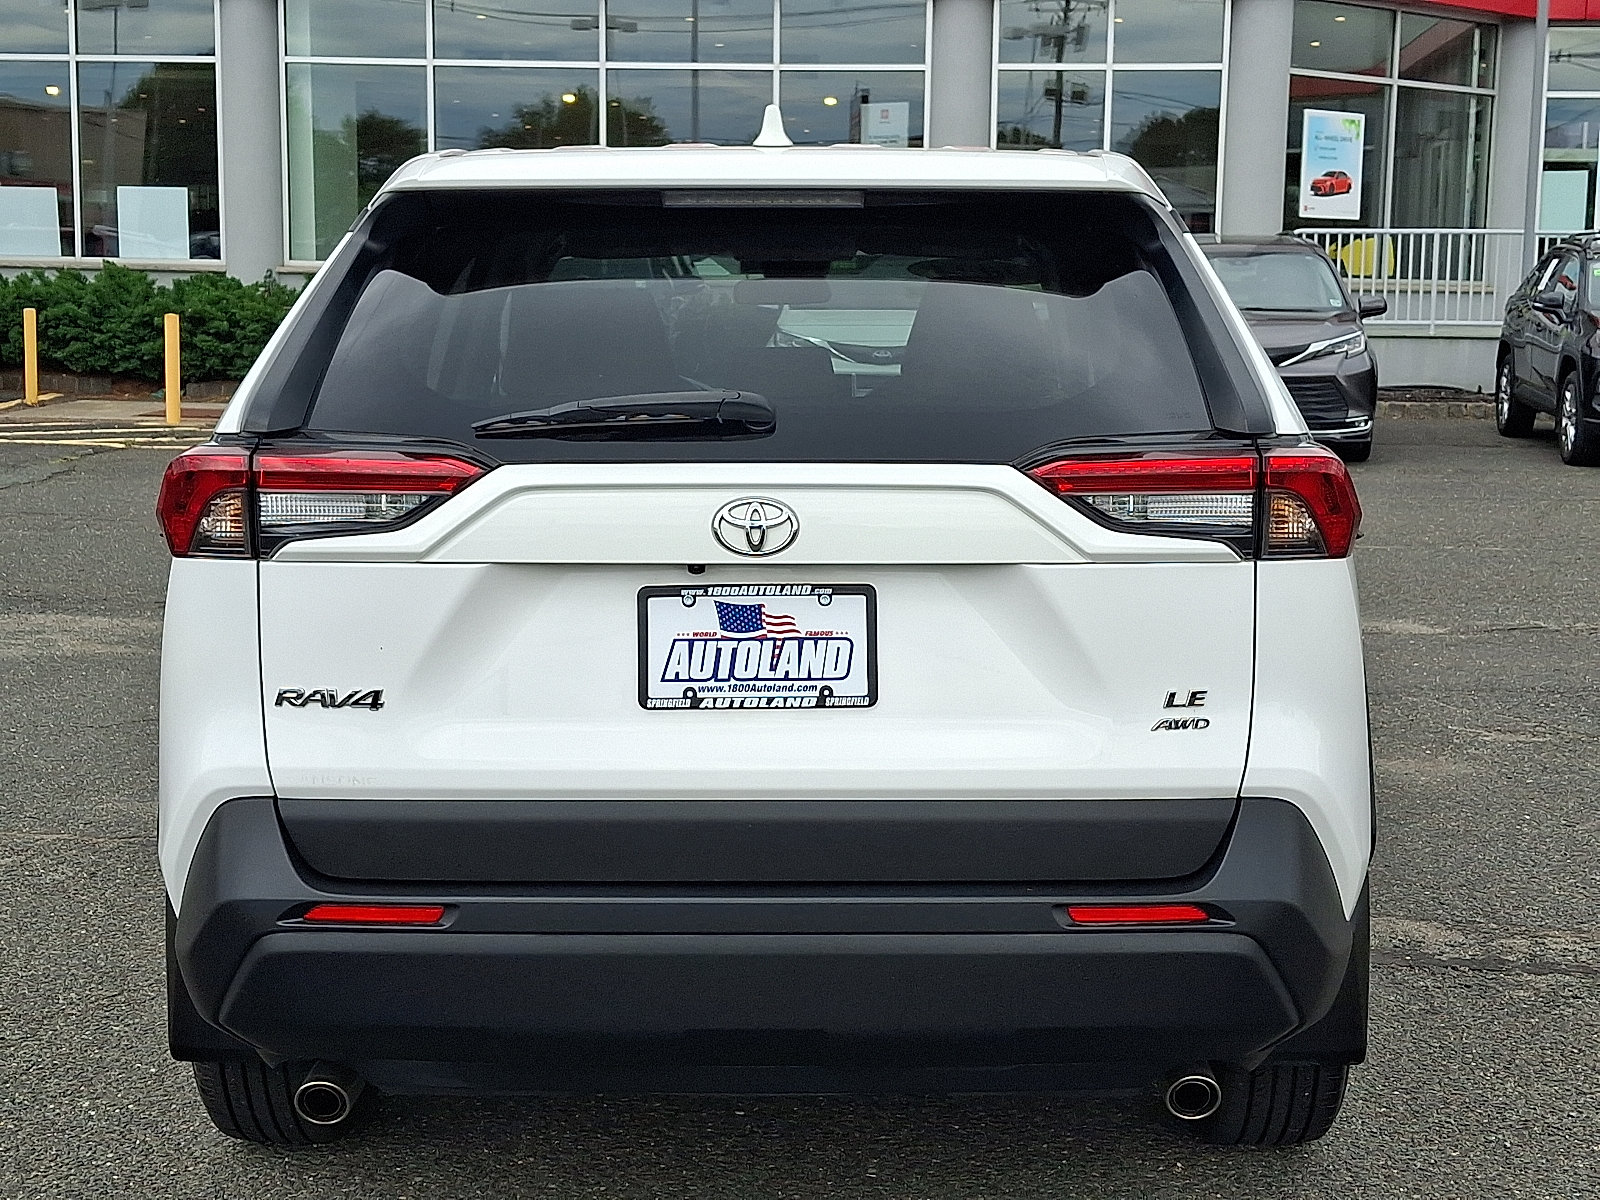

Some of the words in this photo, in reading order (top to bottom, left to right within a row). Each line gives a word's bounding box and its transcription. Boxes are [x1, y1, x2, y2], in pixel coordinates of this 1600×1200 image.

[681, 585, 833, 596] www.1800AUTOLAND.com
[660, 637, 854, 682] AUTOLAND
[697, 683, 818, 694] www.1800Autoland.com
[274, 688, 385, 711] RAV4
[646, 698, 692, 708] SPRINGFIELD
[698, 697, 818, 708] AUTOLAND
[824, 696, 870, 707] SPRINGFIELD
[1163, 689, 1208, 709] LE
[1150, 717, 1210, 732] AWD
